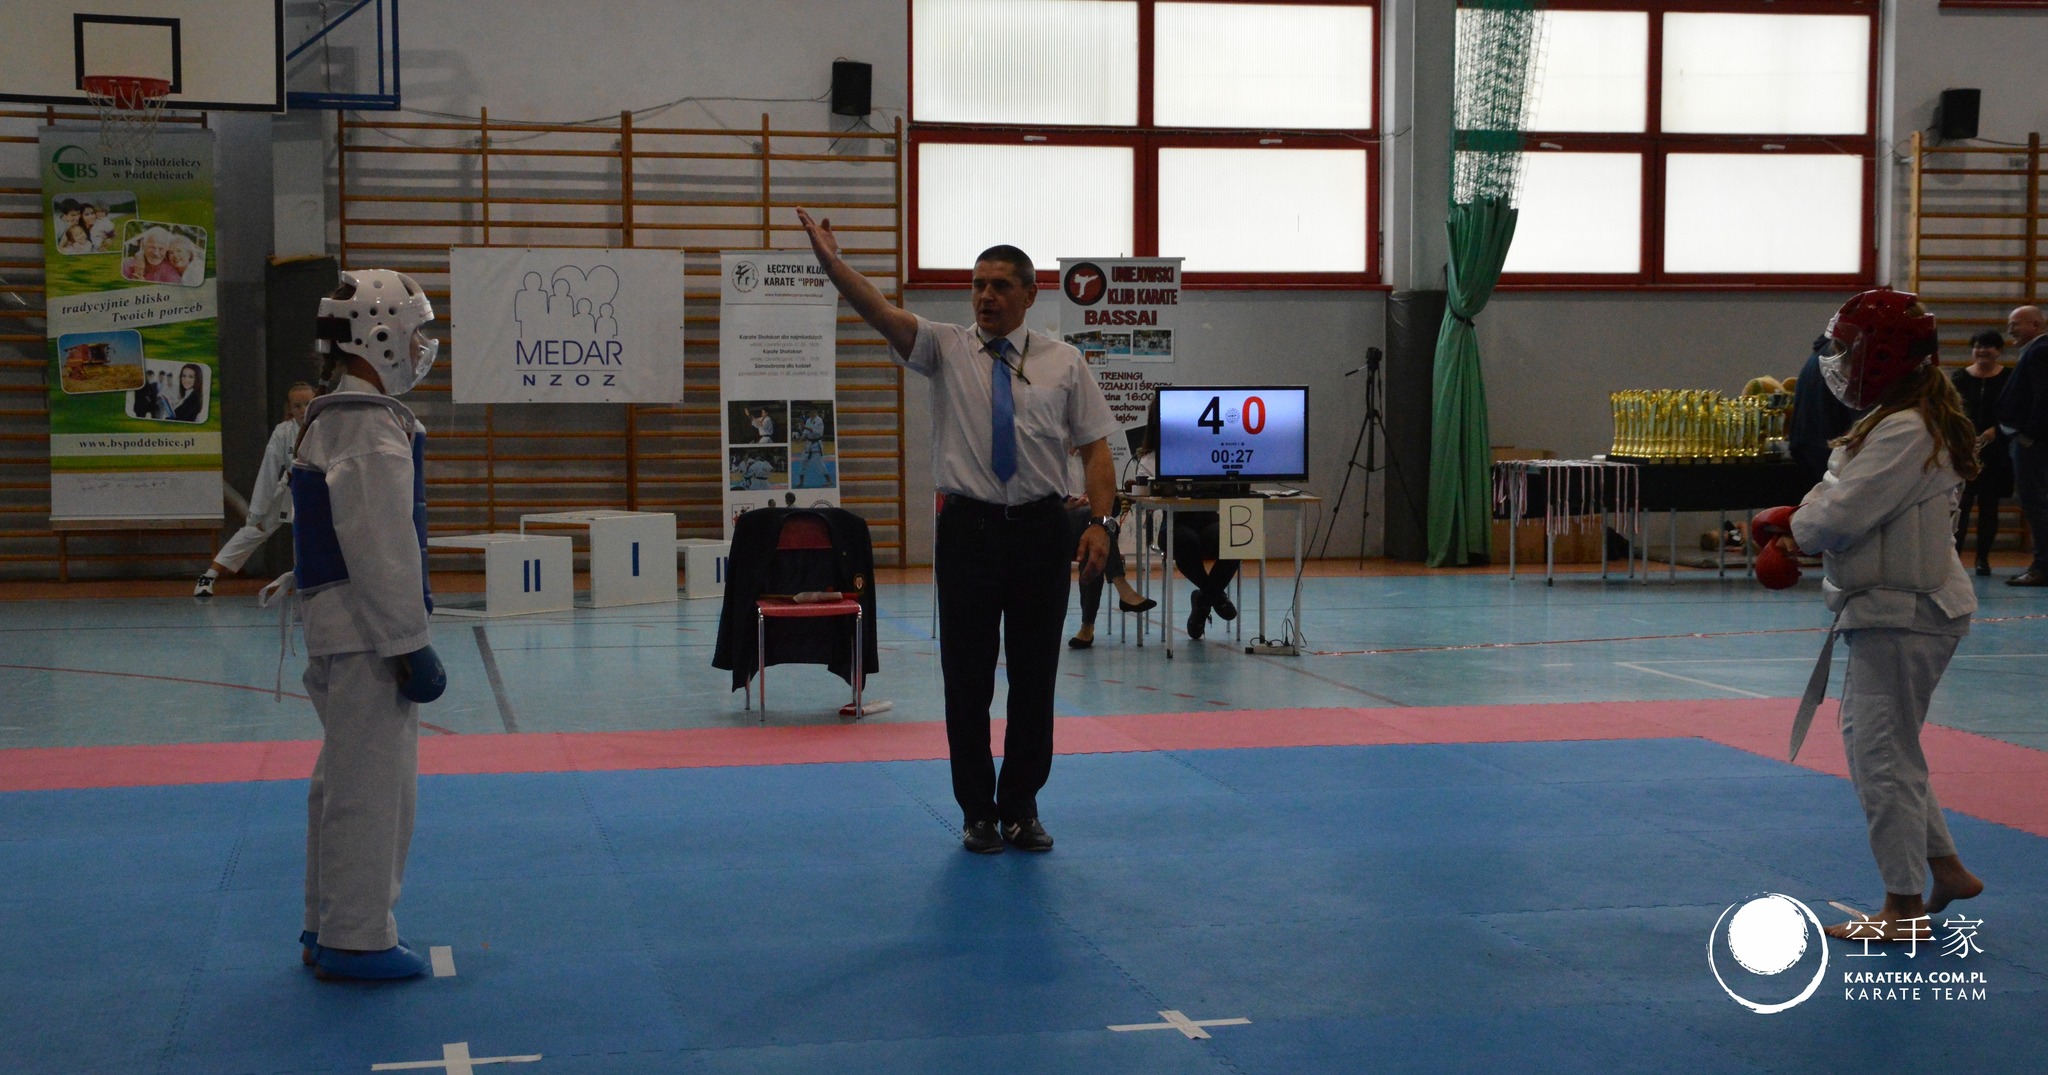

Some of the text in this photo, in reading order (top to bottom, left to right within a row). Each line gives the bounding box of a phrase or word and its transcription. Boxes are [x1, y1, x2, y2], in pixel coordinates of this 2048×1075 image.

[103, 157, 131, 166] Bank
[76, 163, 98, 178] BS
[125, 171, 194, 181] Poddębicach
[767, 264, 804, 275] ŁĘCZYCKI
[1111, 266, 1175, 283] UNIEJOWSKI
[764, 277, 795, 287] KARATE
[62, 293, 170, 315] tradycyjnie blisko
[1107, 288, 1178, 305] KLUB KARATE
[112, 302, 203, 323] Twoich potrzeb
[1084, 309, 1158, 326] BASSAI
[516, 340, 623, 366] MEDAR
[1099, 371, 1143, 381] TRENINGI
[1098, 381, 1134, 391] DZIAŁKI
[1197, 395, 1266, 435] 4 0
[79, 437, 195, 450] www.bspoddebice.pl
[1211, 449, 1254, 463] 00:27
[1229, 505, 1254, 548] B
